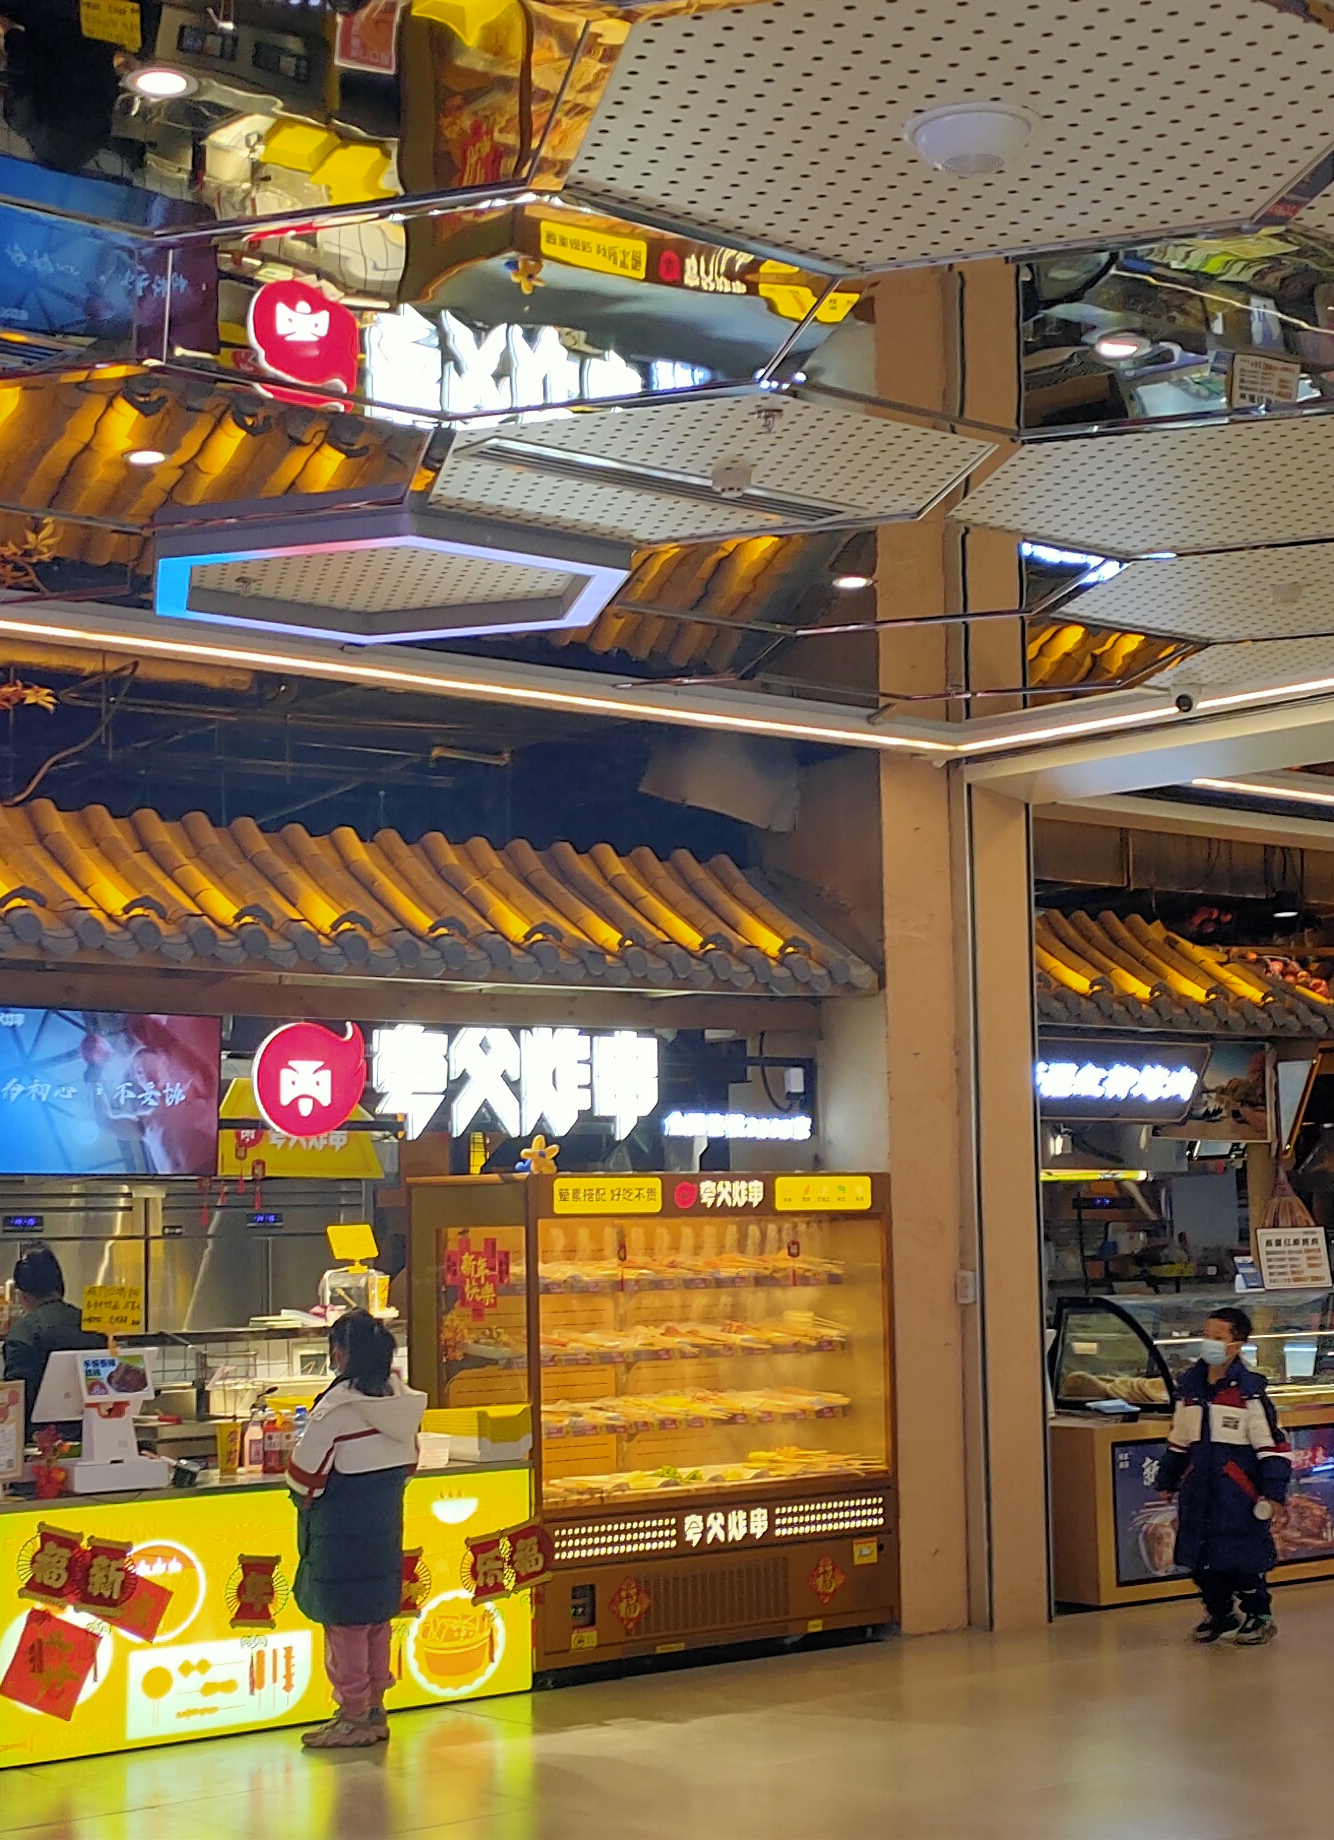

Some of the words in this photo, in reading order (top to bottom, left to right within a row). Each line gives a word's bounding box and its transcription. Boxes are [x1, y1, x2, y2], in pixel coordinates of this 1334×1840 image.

[372, 1024, 659, 1140] 夸父炸串
[700, 1180, 765, 1209] 夸父炸串
[684, 1507, 769, 1547] 夸父炸串
[31, 1541, 73, 1588] 福
[87, 1554, 126, 1600] 新
